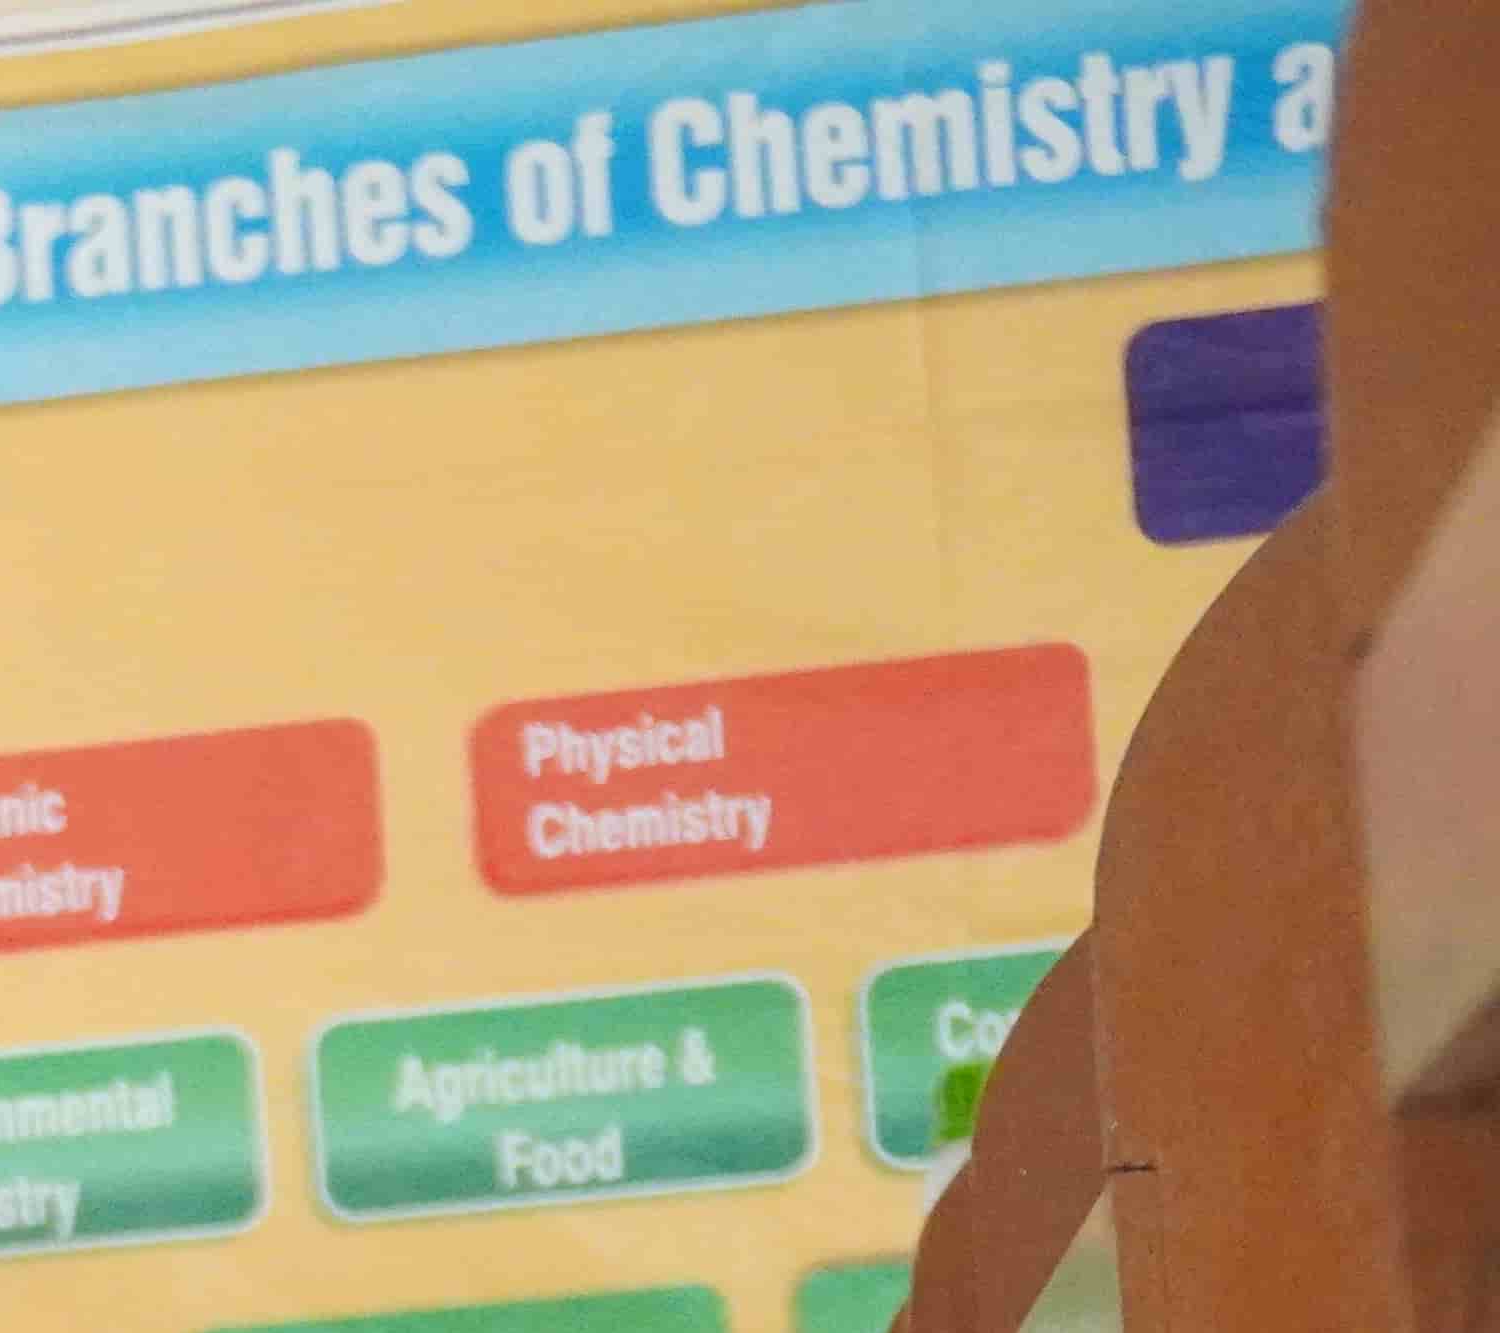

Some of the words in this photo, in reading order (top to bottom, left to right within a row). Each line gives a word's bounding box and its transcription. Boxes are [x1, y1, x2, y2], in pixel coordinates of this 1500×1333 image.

[505, 109, 615, 246] of
[649, 51, 1234, 226] Chemistry
[522, 704, 724, 784] Physical
[527, 789, 771, 858] Chemistry
[394, 1040, 666, 1122] Agriculture
[677, 1026, 716, 1085] &
[495, 1121, 623, 1189] Food
